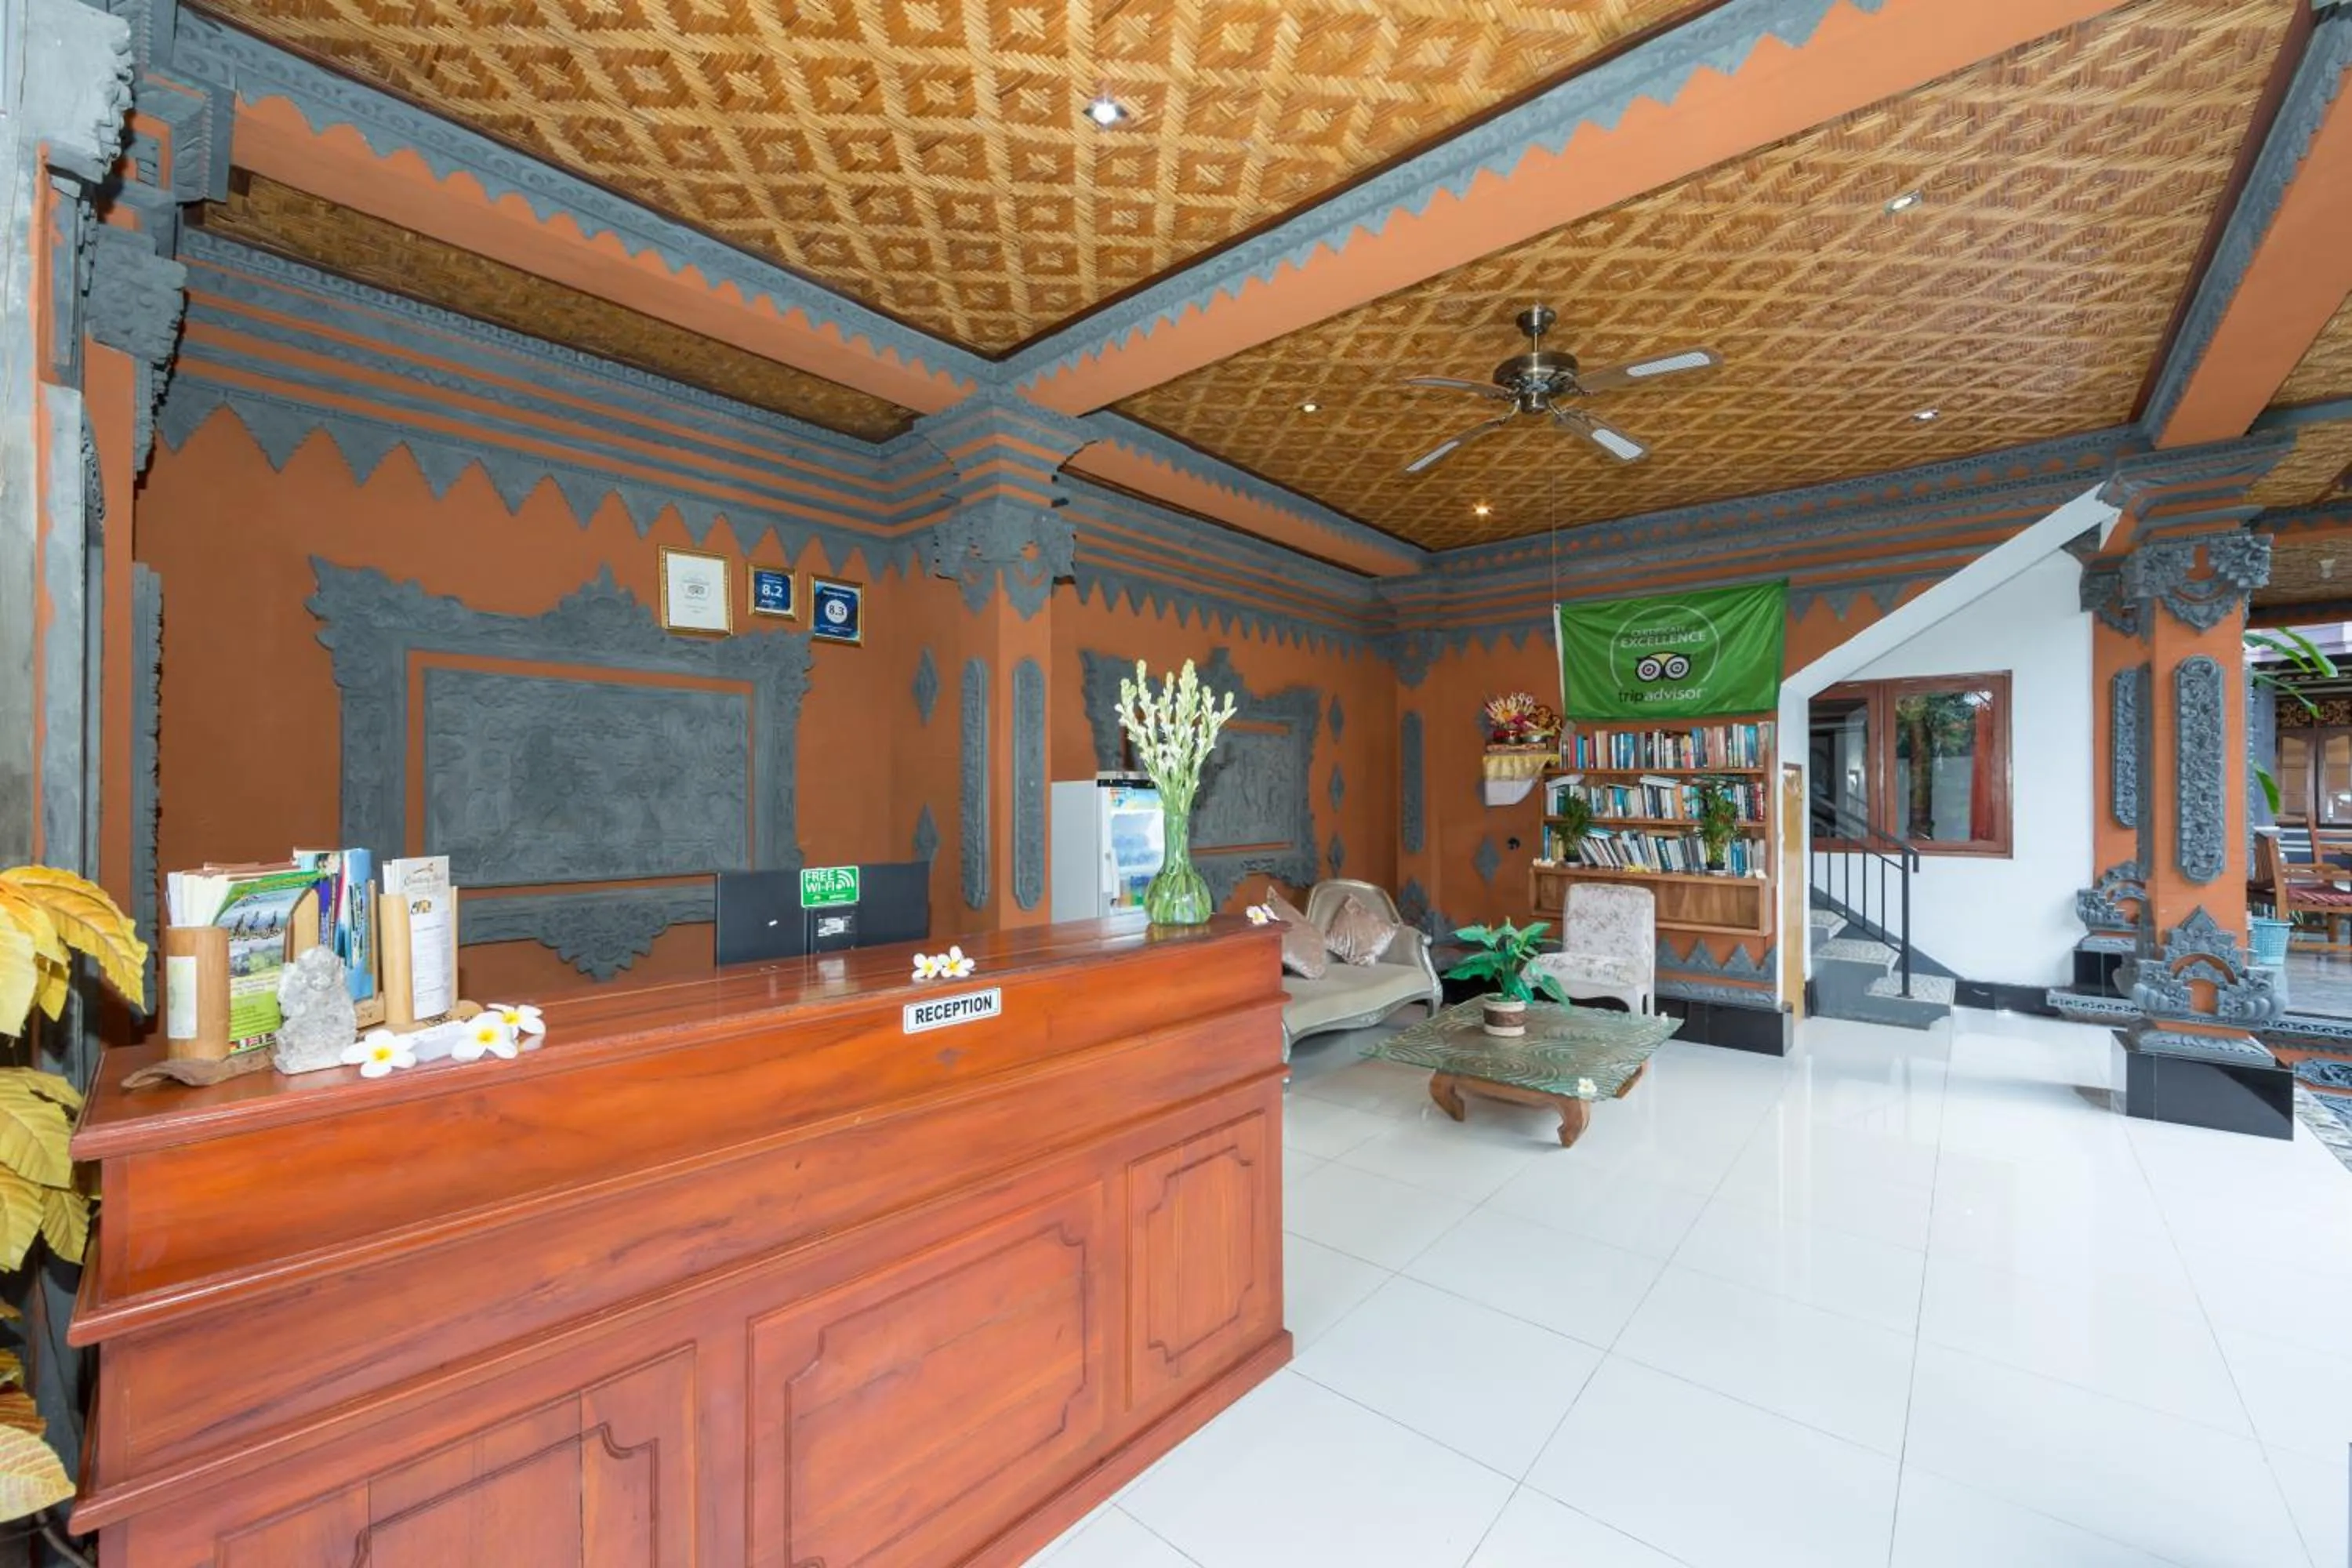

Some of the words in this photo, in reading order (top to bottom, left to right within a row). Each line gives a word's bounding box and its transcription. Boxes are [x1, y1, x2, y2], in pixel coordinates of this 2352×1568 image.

[762, 584, 782, 598] 8.2
[829, 604, 844, 615] 8.3
[1620, 630, 1706, 648] EXCELLENCE
[1618, 687, 1703, 704] tripadvisor
[805, 869, 834, 882] FREE
[915, 995, 992, 1025] RECEPTION
